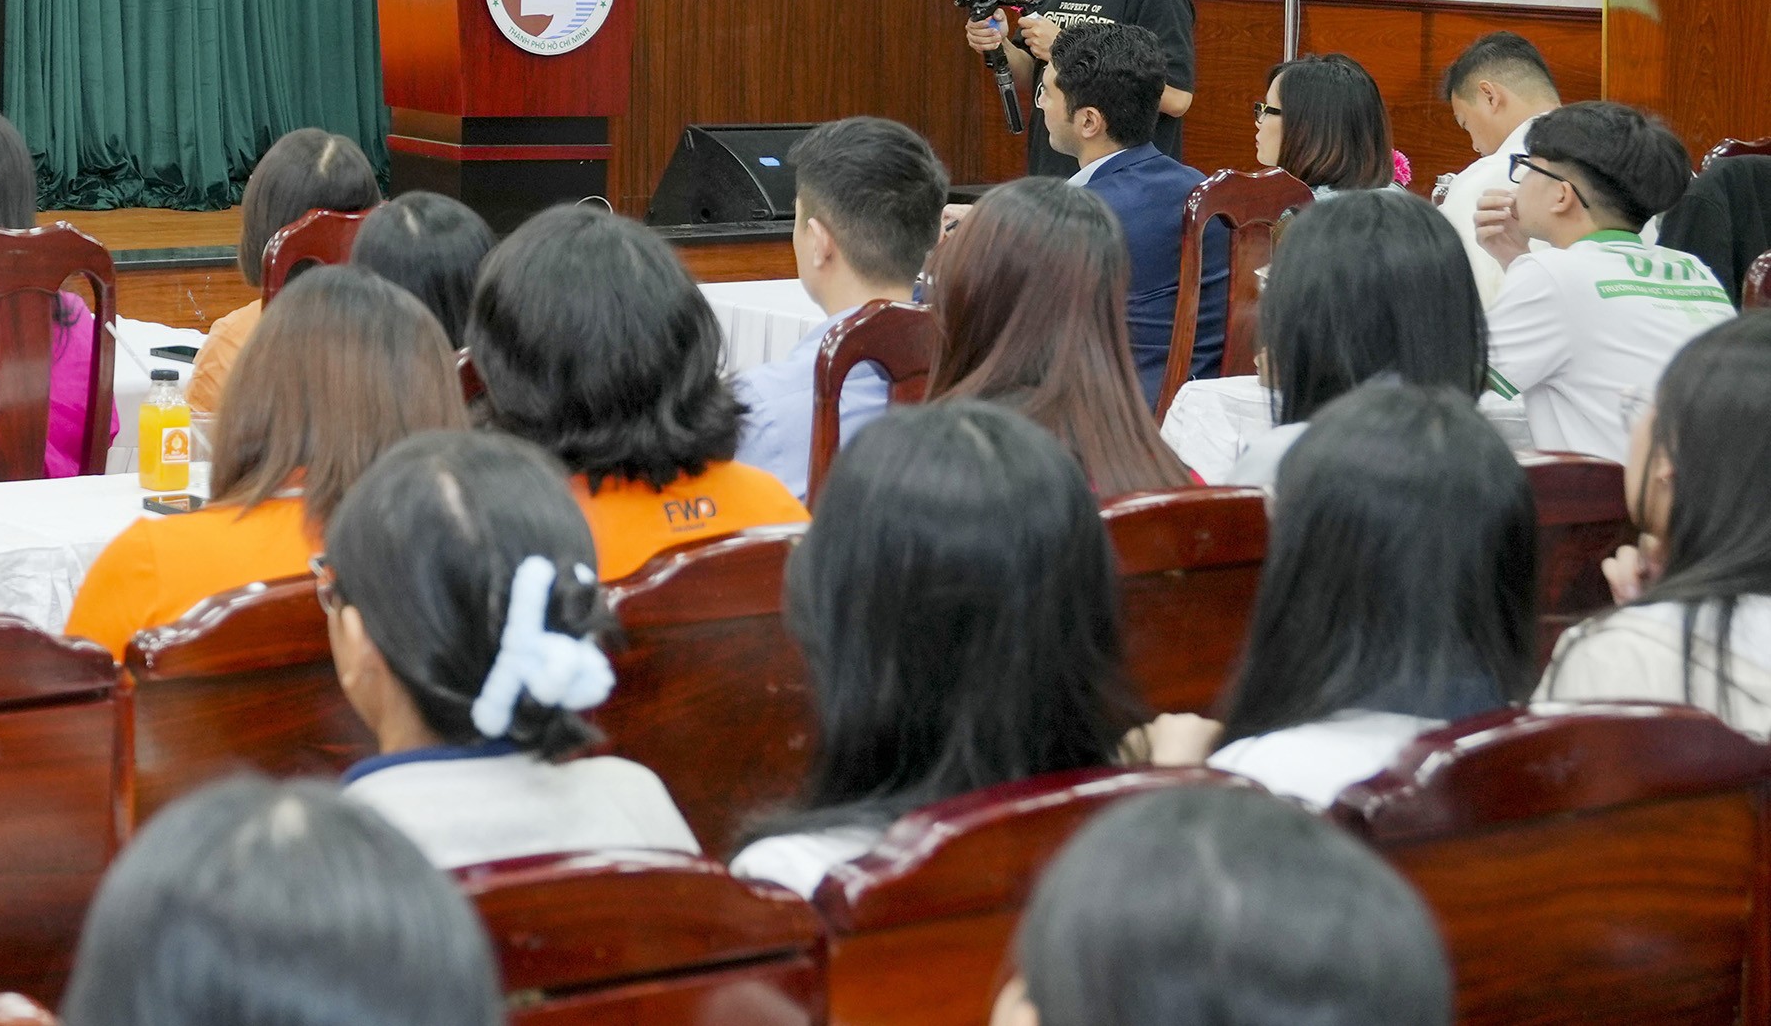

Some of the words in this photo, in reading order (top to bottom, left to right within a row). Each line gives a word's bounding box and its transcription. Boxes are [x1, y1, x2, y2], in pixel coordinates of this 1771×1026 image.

[1059, 1, 1090, 12] PROPERTY
[1091, 4, 1103, 13] OF
[508, 27, 530, 45] THÀNH
[531, 40, 546, 50] PHỐ
[559, 39, 571, 49] CHÍ
[571, 27, 590, 44] MINH
[664, 498, 717, 523] FWD
